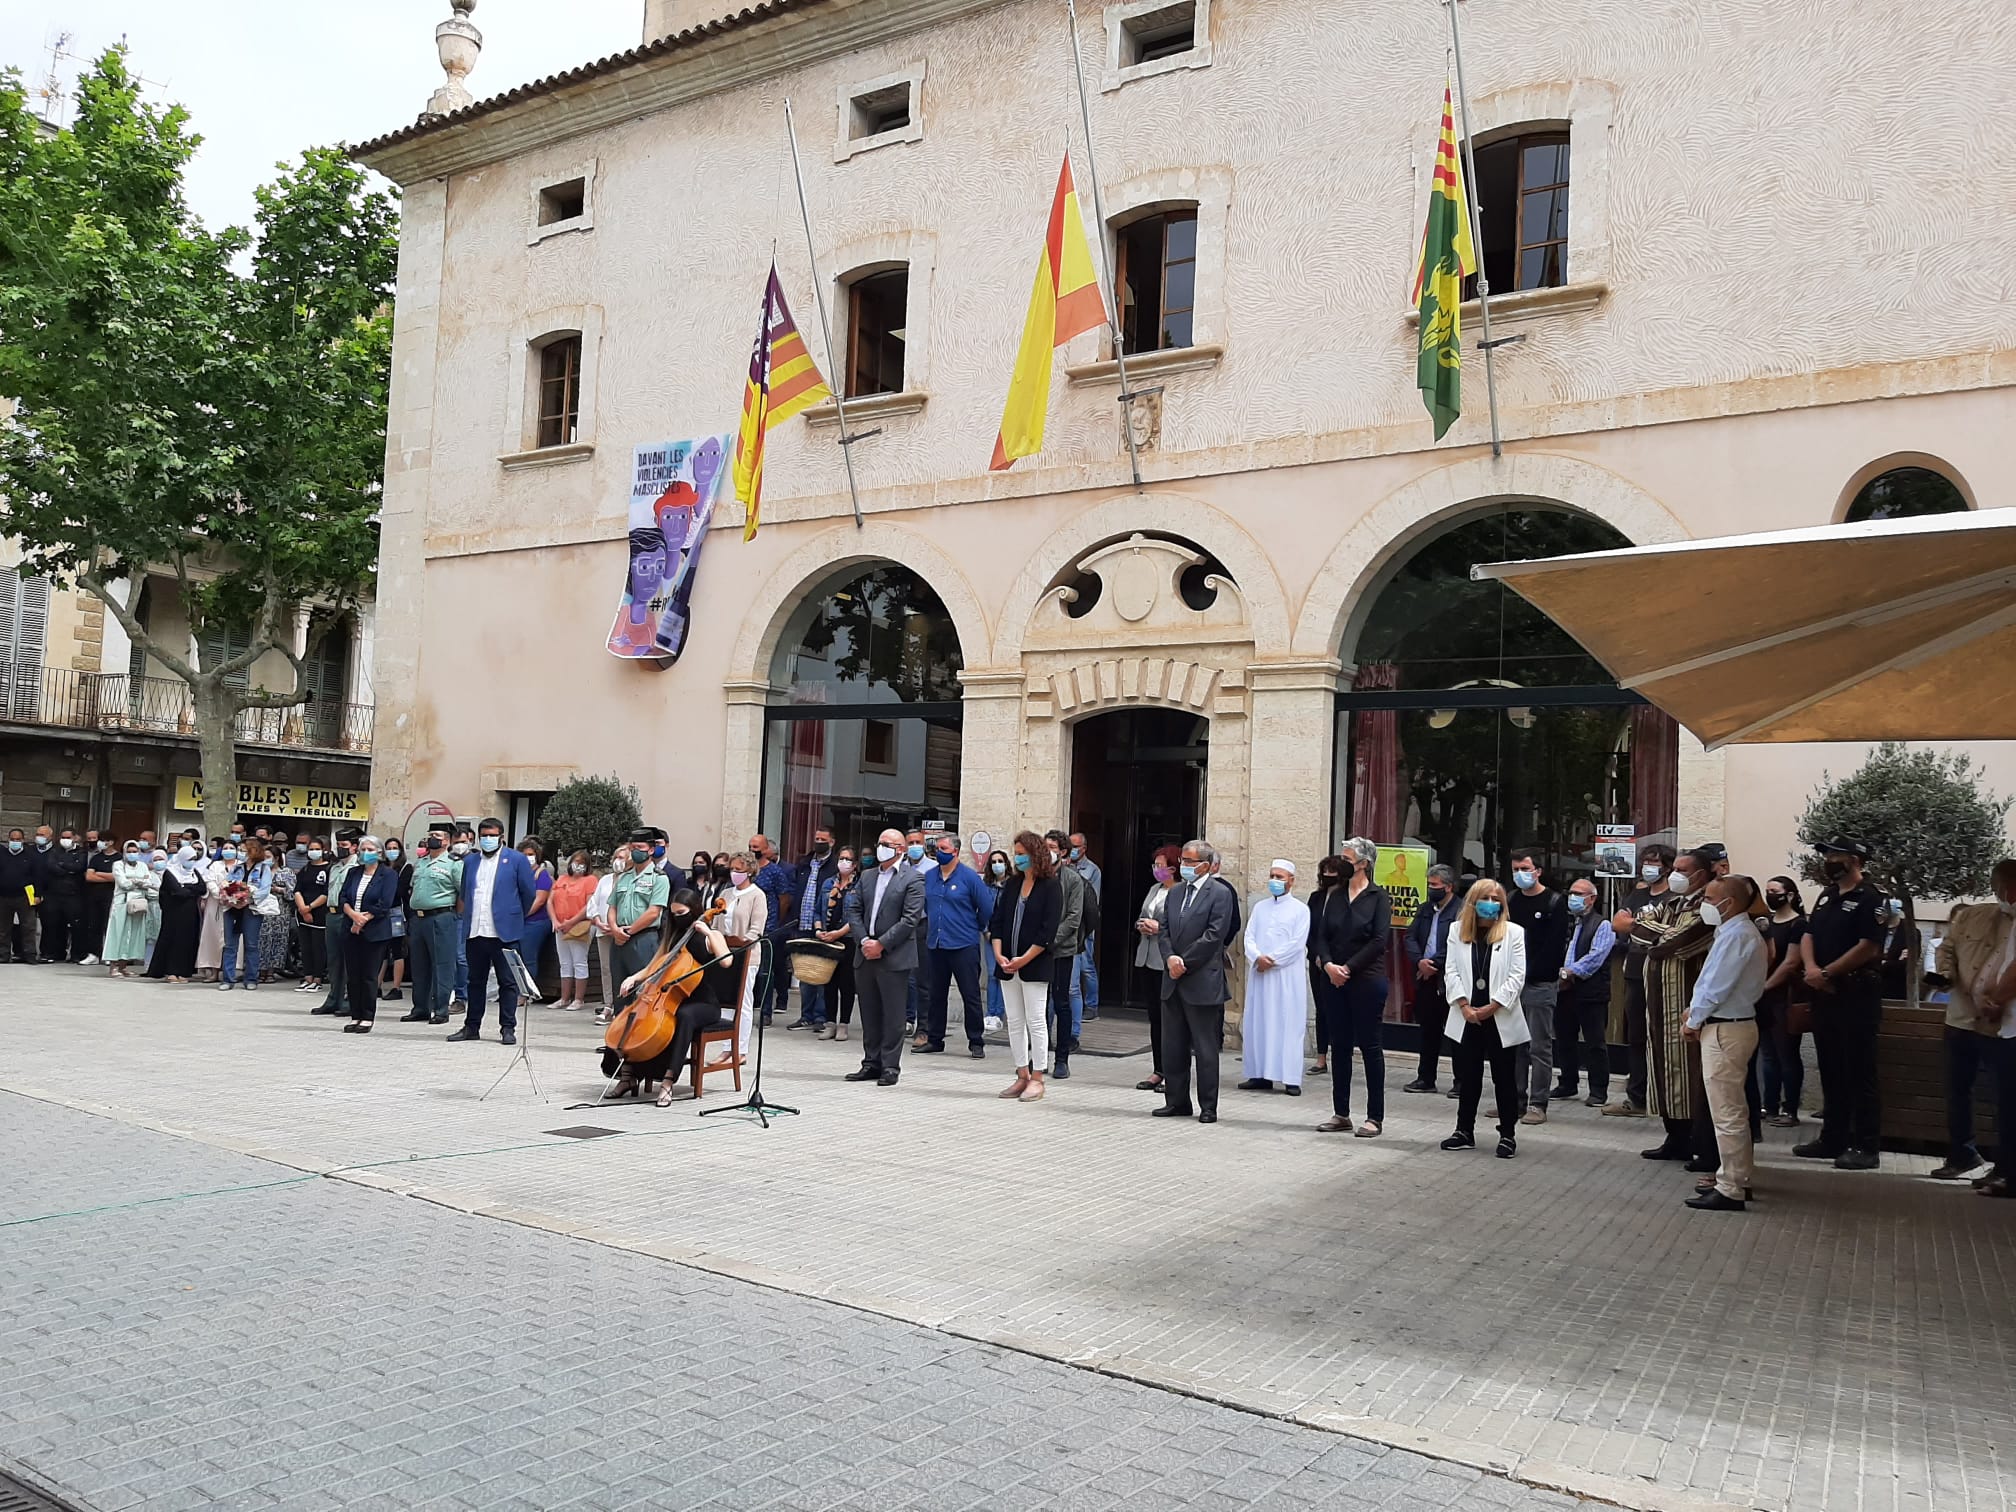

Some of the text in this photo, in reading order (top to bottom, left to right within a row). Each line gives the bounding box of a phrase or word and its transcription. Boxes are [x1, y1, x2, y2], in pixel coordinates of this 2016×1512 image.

[638, 449, 684, 467] DAVANT LES
[192, 781, 357, 810] MBLES PONS
[279, 806, 286, 814] Y
[293, 807, 351, 818] TRESILLOS
